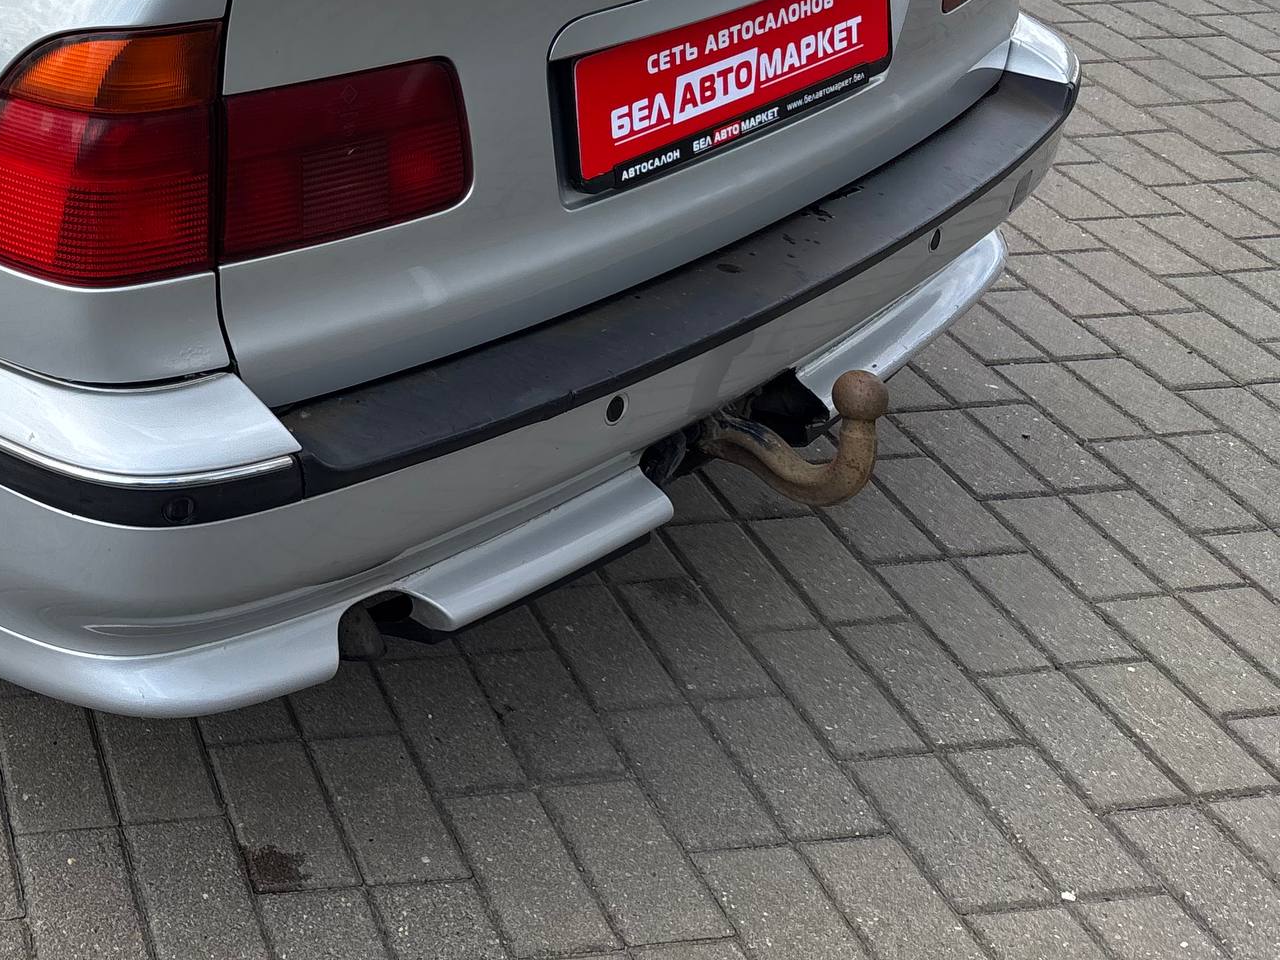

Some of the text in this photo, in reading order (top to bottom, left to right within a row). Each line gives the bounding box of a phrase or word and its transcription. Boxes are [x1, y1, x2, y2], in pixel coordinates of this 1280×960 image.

[647, 42, 699, 75] СЕТЬ
[621, 149, 680, 182] АВТОСАЛОН
[786, 72, 865, 112] www.белавтомаркет.бел
